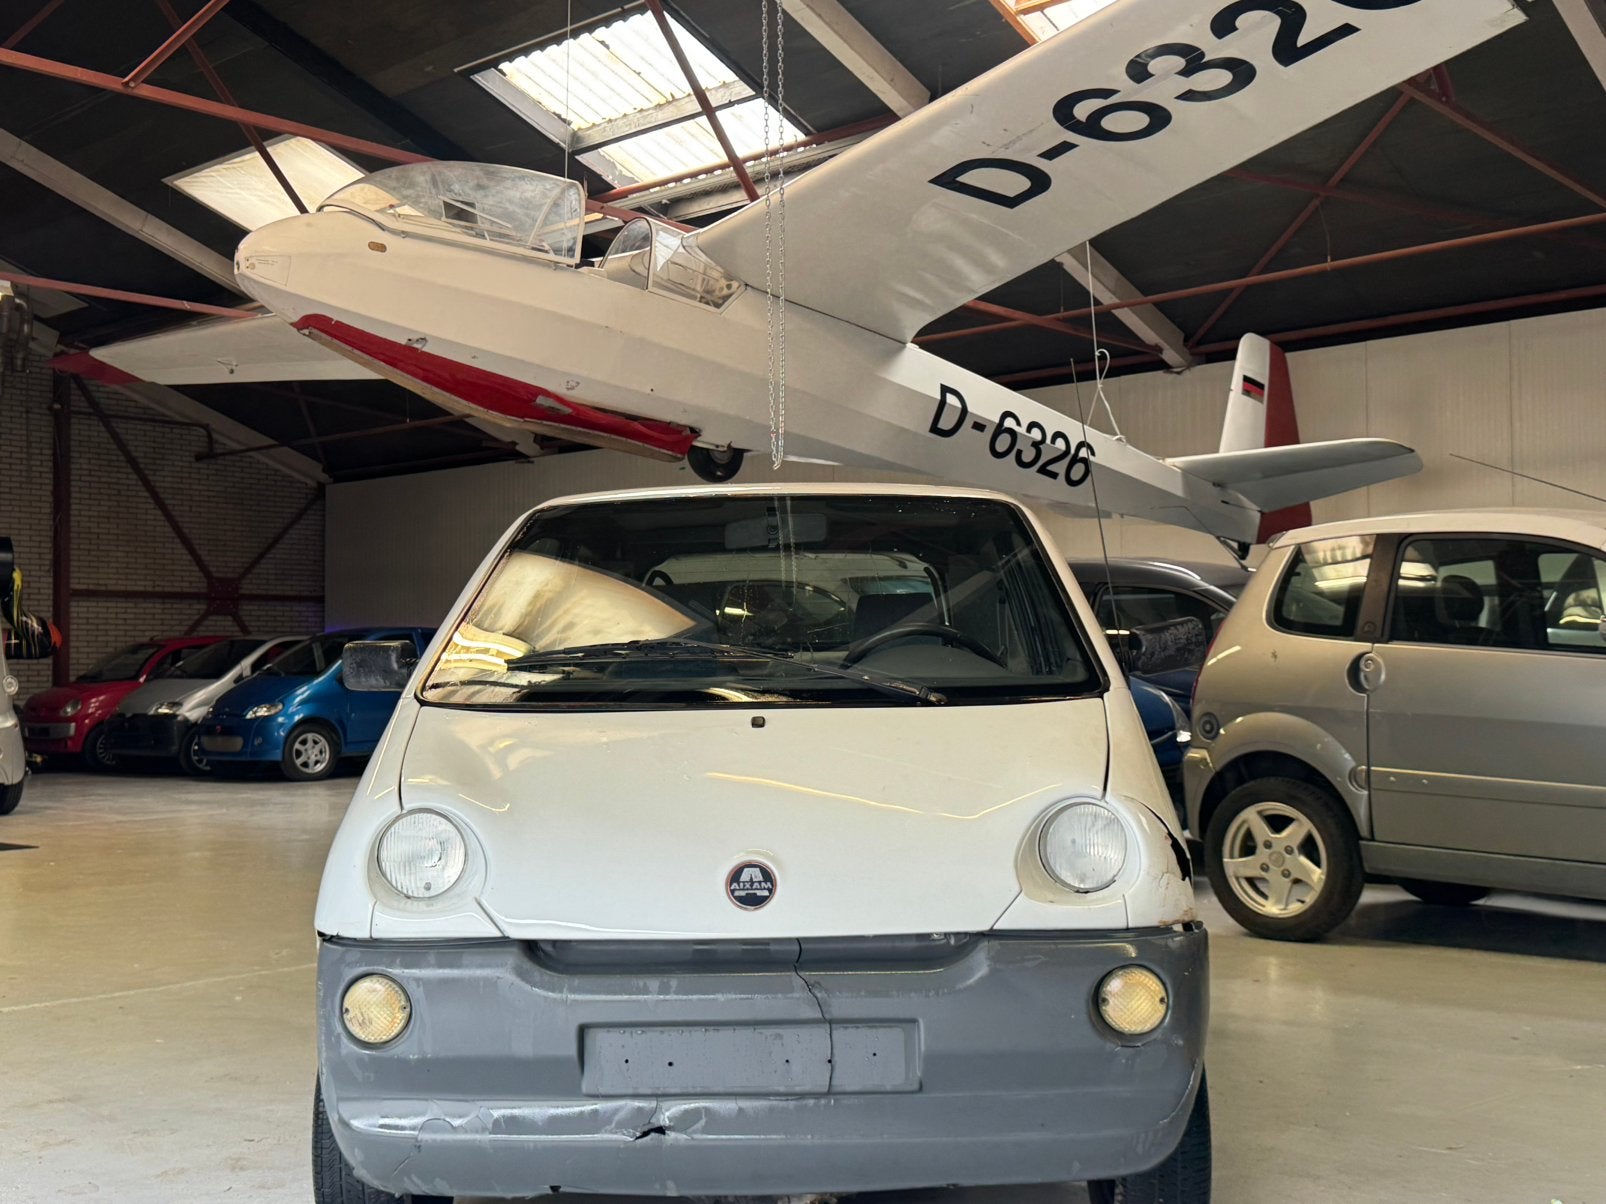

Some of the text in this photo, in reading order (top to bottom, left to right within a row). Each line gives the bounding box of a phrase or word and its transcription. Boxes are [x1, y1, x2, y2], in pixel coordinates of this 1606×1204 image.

[928, 0, 1422, 209] D-632
[929, 383, 1096, 487] D-6326
[730, 881, 773, 890] AIXAM
